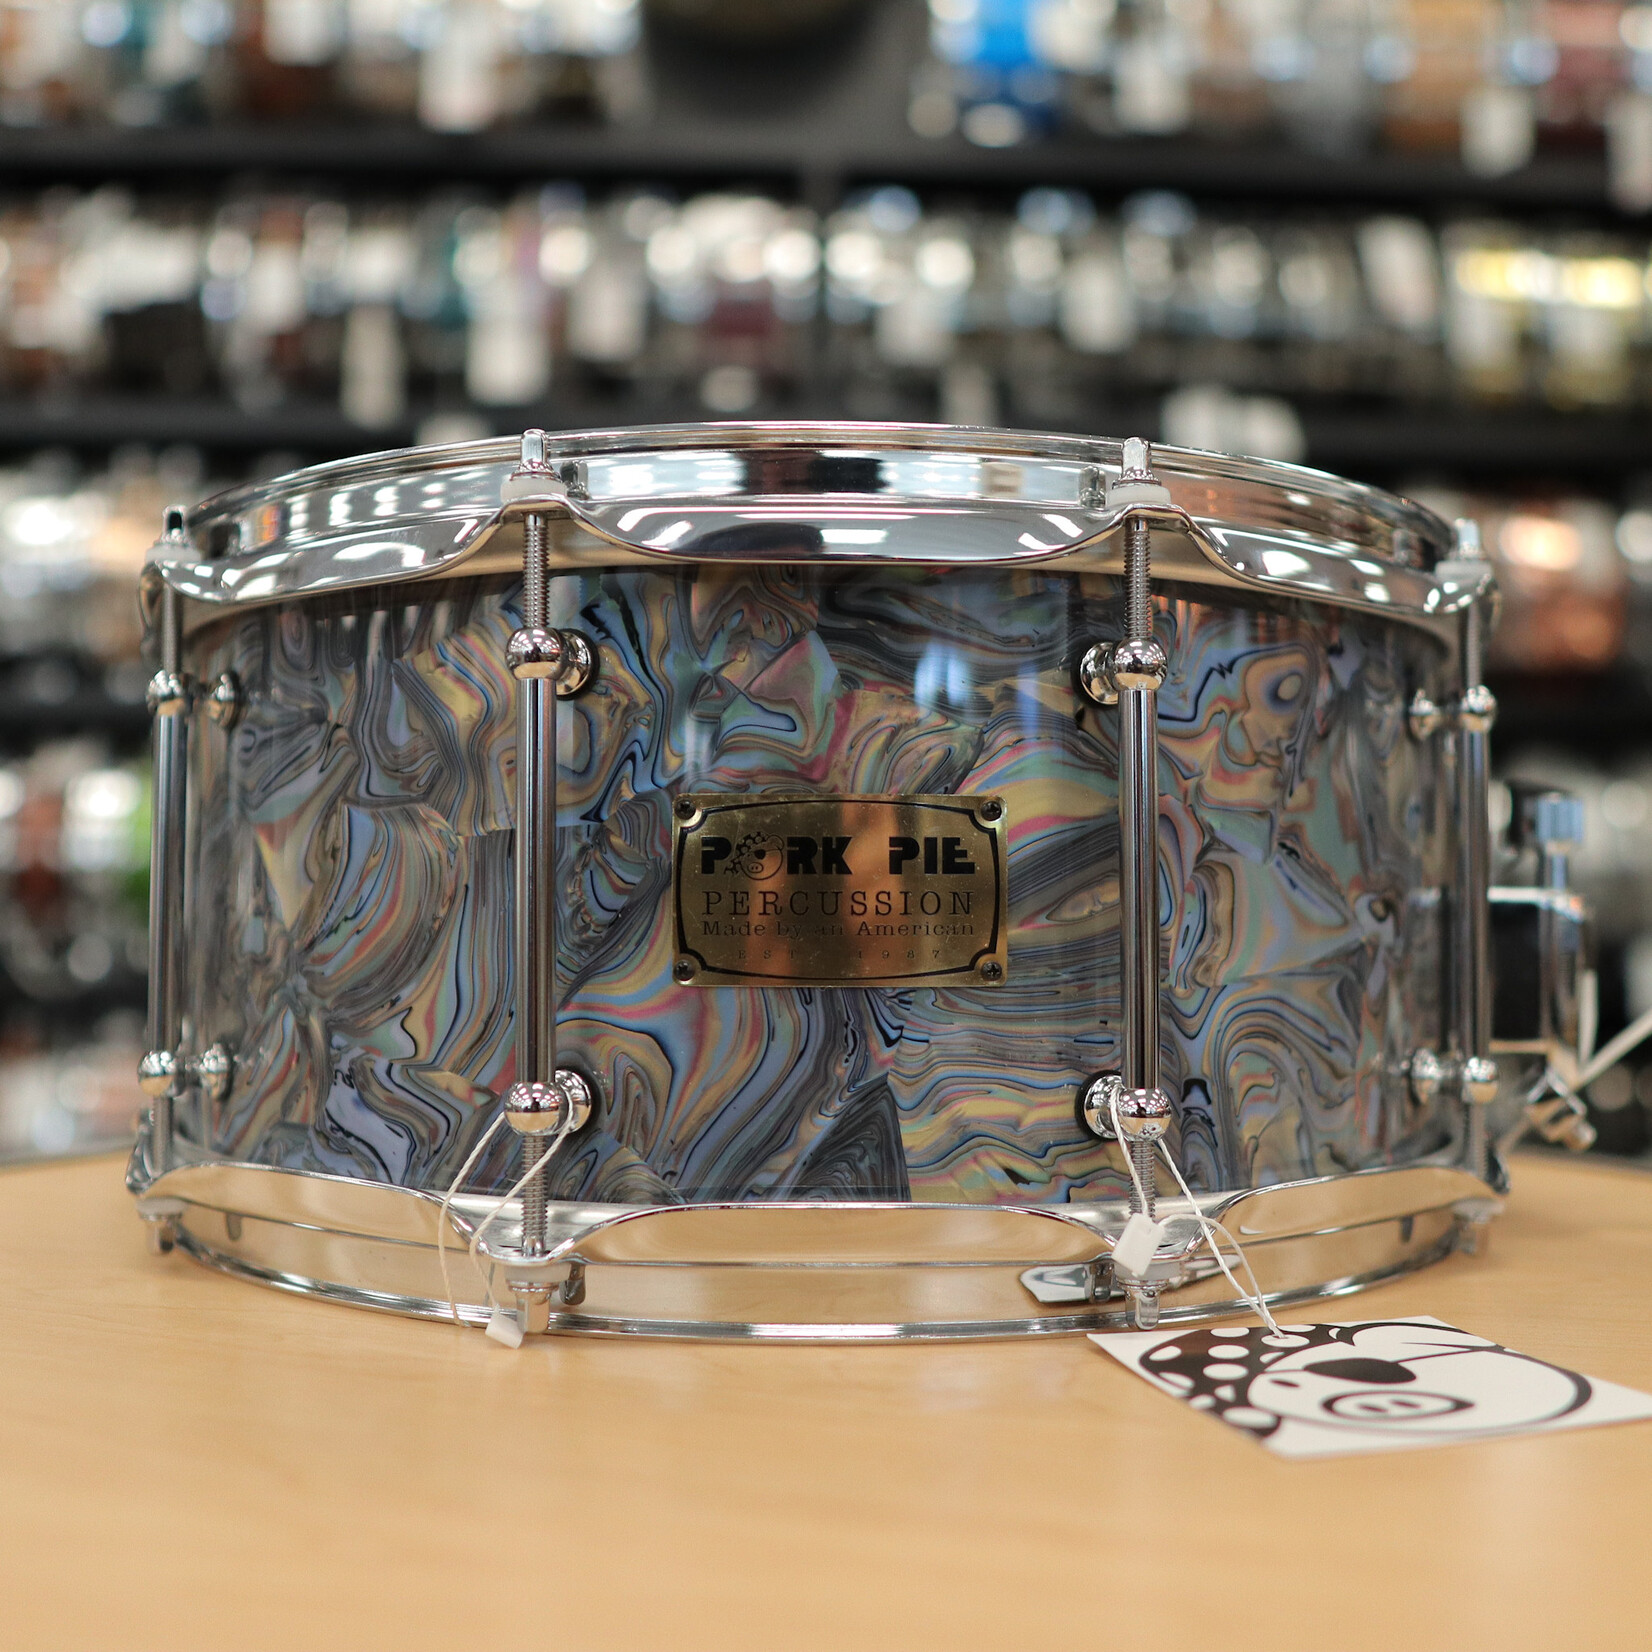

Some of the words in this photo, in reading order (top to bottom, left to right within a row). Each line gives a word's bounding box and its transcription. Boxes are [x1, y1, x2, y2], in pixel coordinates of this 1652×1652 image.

[888, 836, 975, 874] PIE
[702, 891, 974, 916] PERCUSSION
[703, 920, 766, 936] Made
[777, 920, 801, 939] by
[810, 923, 844, 936] an
[856, 920, 974, 936] American
[857, 949, 941, 960] 1987
